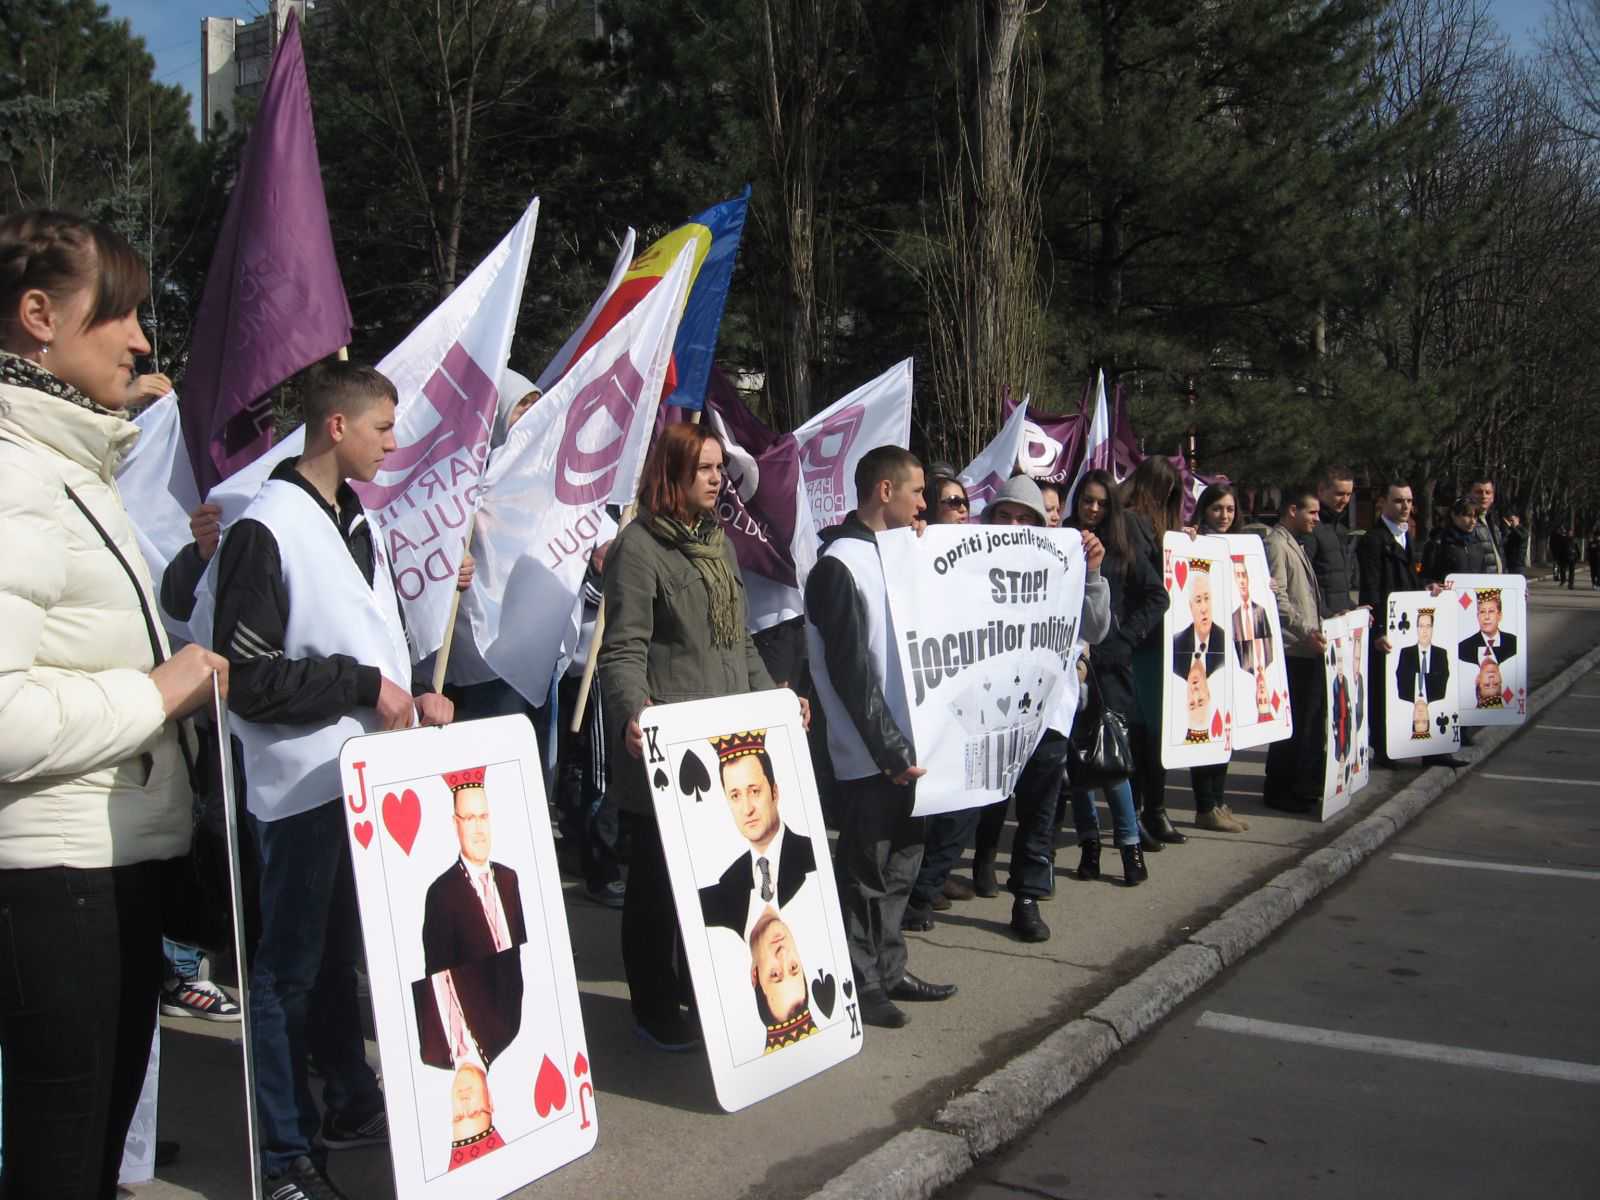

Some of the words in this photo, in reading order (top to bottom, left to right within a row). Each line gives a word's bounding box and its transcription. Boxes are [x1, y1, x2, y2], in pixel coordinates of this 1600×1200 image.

[1164, 548, 1173, 574] K
[988, 567, 1048, 604] STOP!
[1389, 600, 1397, 619] K
[906, 620, 1025, 707] jocurilor
[643, 725, 666, 764] K
[1451, 725, 1460, 743] K
[348, 761, 367, 814] J
[846, 1002, 861, 1040] K
[579, 1081, 593, 1130] J
